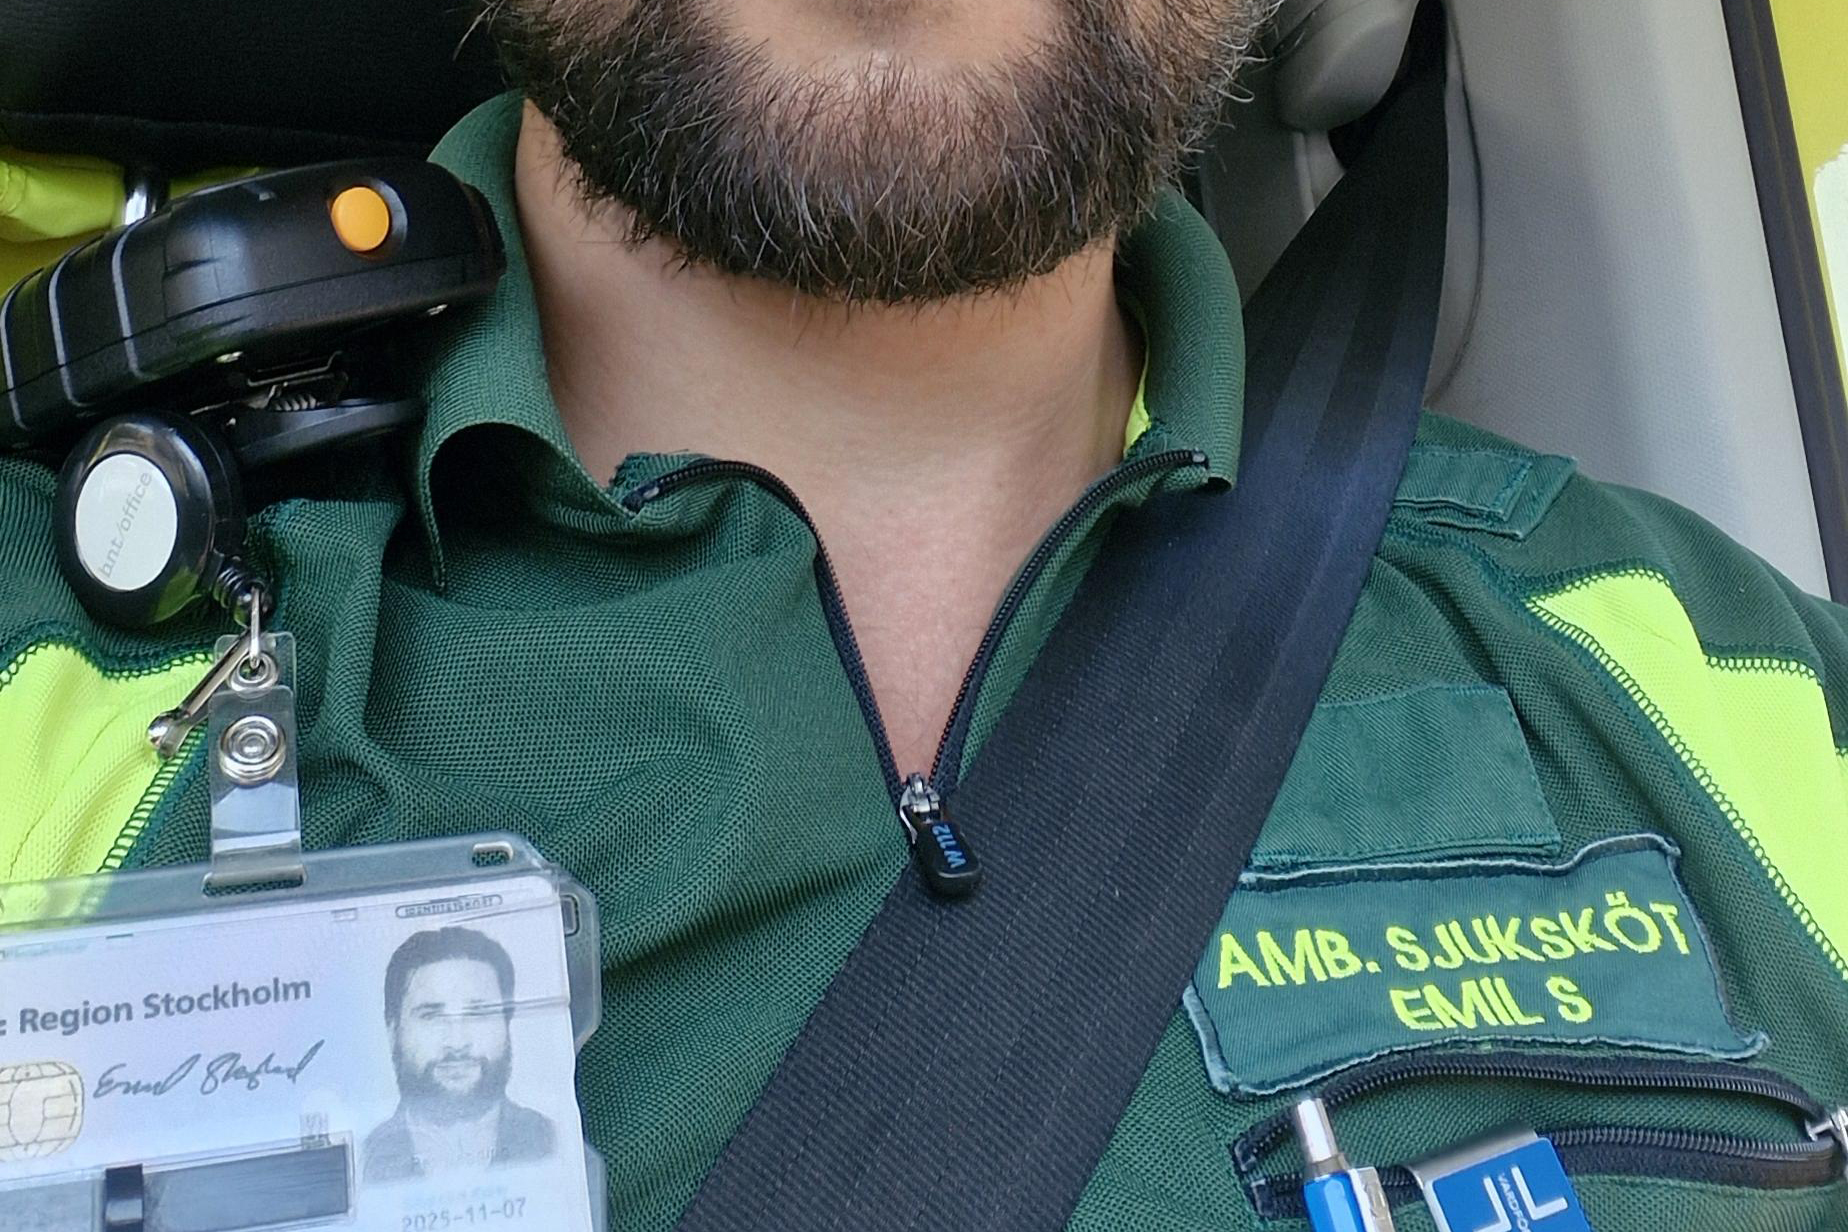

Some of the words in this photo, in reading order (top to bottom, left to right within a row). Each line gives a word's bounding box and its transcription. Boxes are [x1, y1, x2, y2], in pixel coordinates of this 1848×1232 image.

[1217, 928, 1382, 989] AMB.
[1385, 890, 1690, 971] SJUKSKÖT
[19, 1000, 134, 1036] Region
[142, 976, 312, 1020] Stockholm
[1389, 976, 1546, 1031] EMIL
[1545, 975, 1593, 1024] S
[402, 1196, 526, 1232] 2025-11-07
